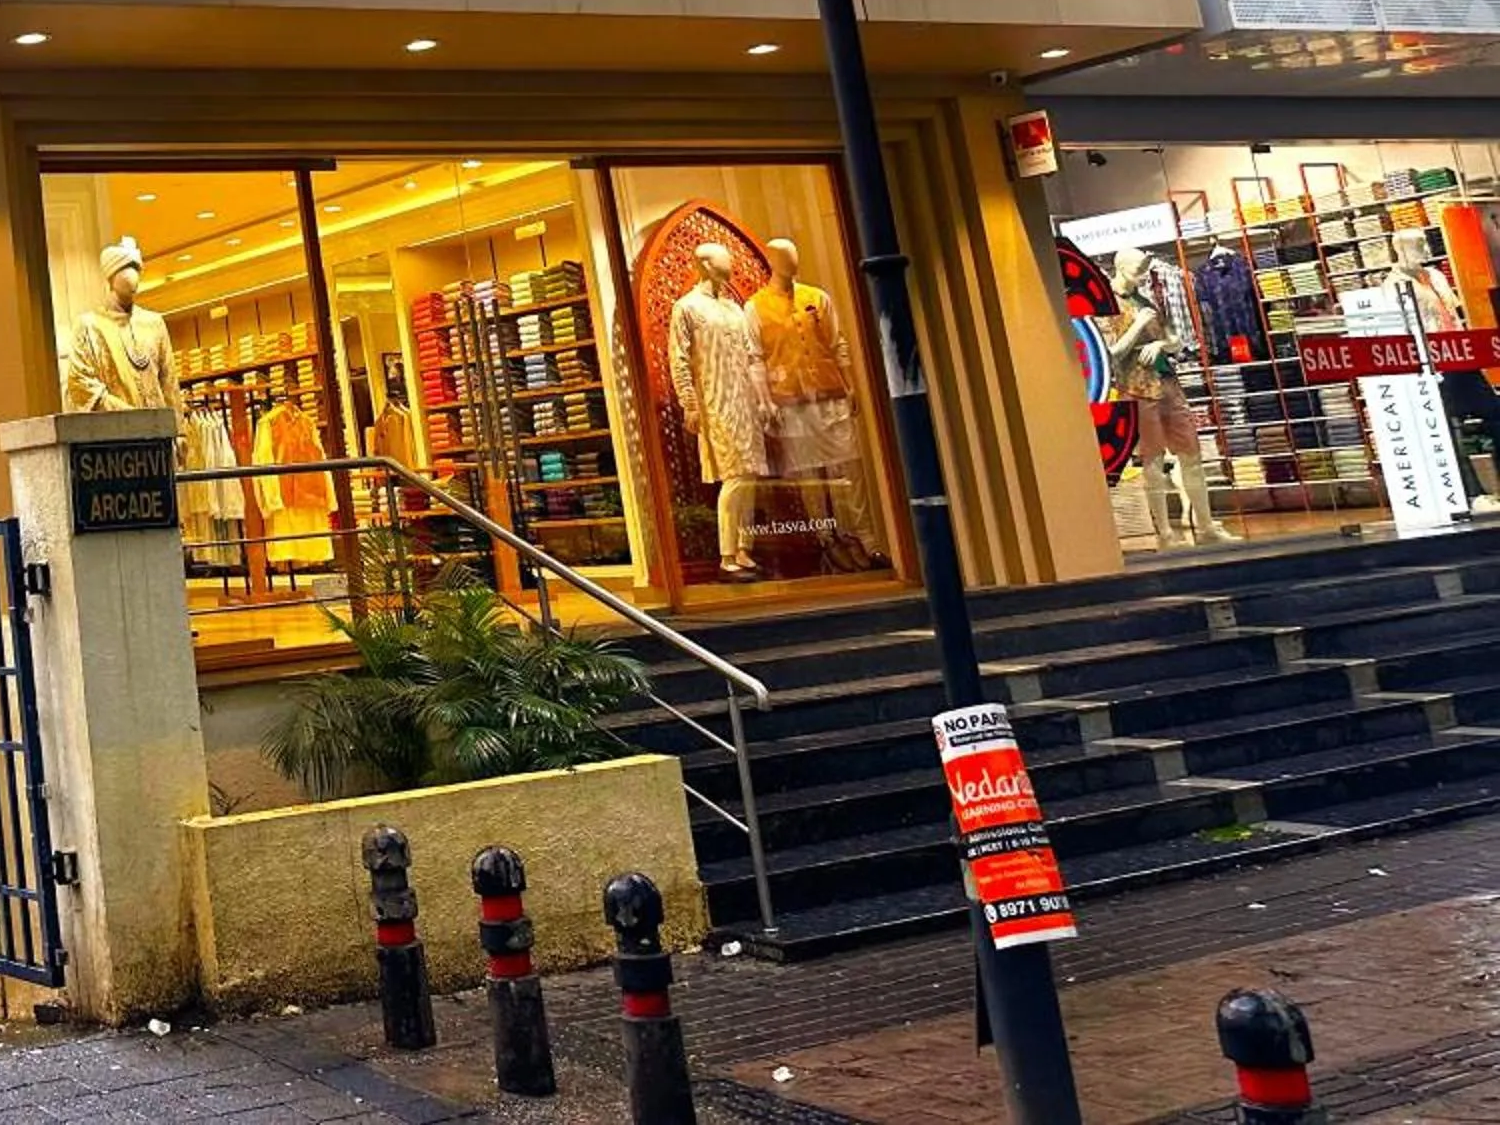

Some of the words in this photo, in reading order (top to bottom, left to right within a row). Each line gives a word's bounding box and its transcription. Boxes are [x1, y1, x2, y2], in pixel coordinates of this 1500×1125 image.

[1303, 346, 1354, 372] SALE
[1372, 342, 1420, 367] SALE
[1428, 338, 1476, 363] SALE
[1378, 383, 1421, 509] AMERICAN
[80, 450, 167, 481] SANGHVI
[90, 490, 163, 522] ARCADE
[738, 518, 837, 536] www.tasva.com
[944, 714, 968, 732] NO
